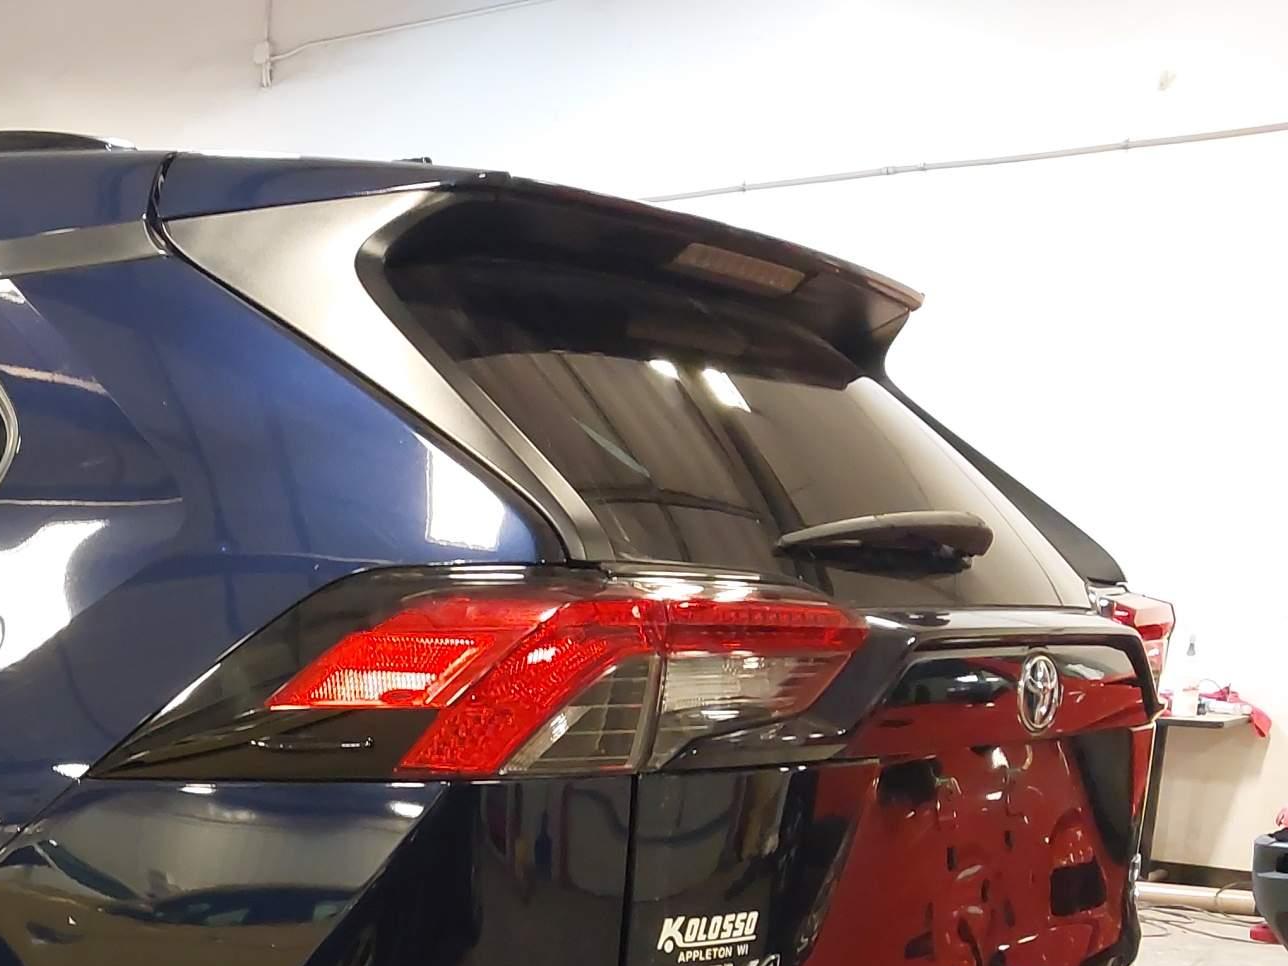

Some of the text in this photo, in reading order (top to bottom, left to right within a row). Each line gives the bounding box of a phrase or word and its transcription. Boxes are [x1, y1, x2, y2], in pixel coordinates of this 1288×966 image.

[657, 910, 759, 953] KOLOSSO
[678, 943, 749, 964] APPLETON WI
